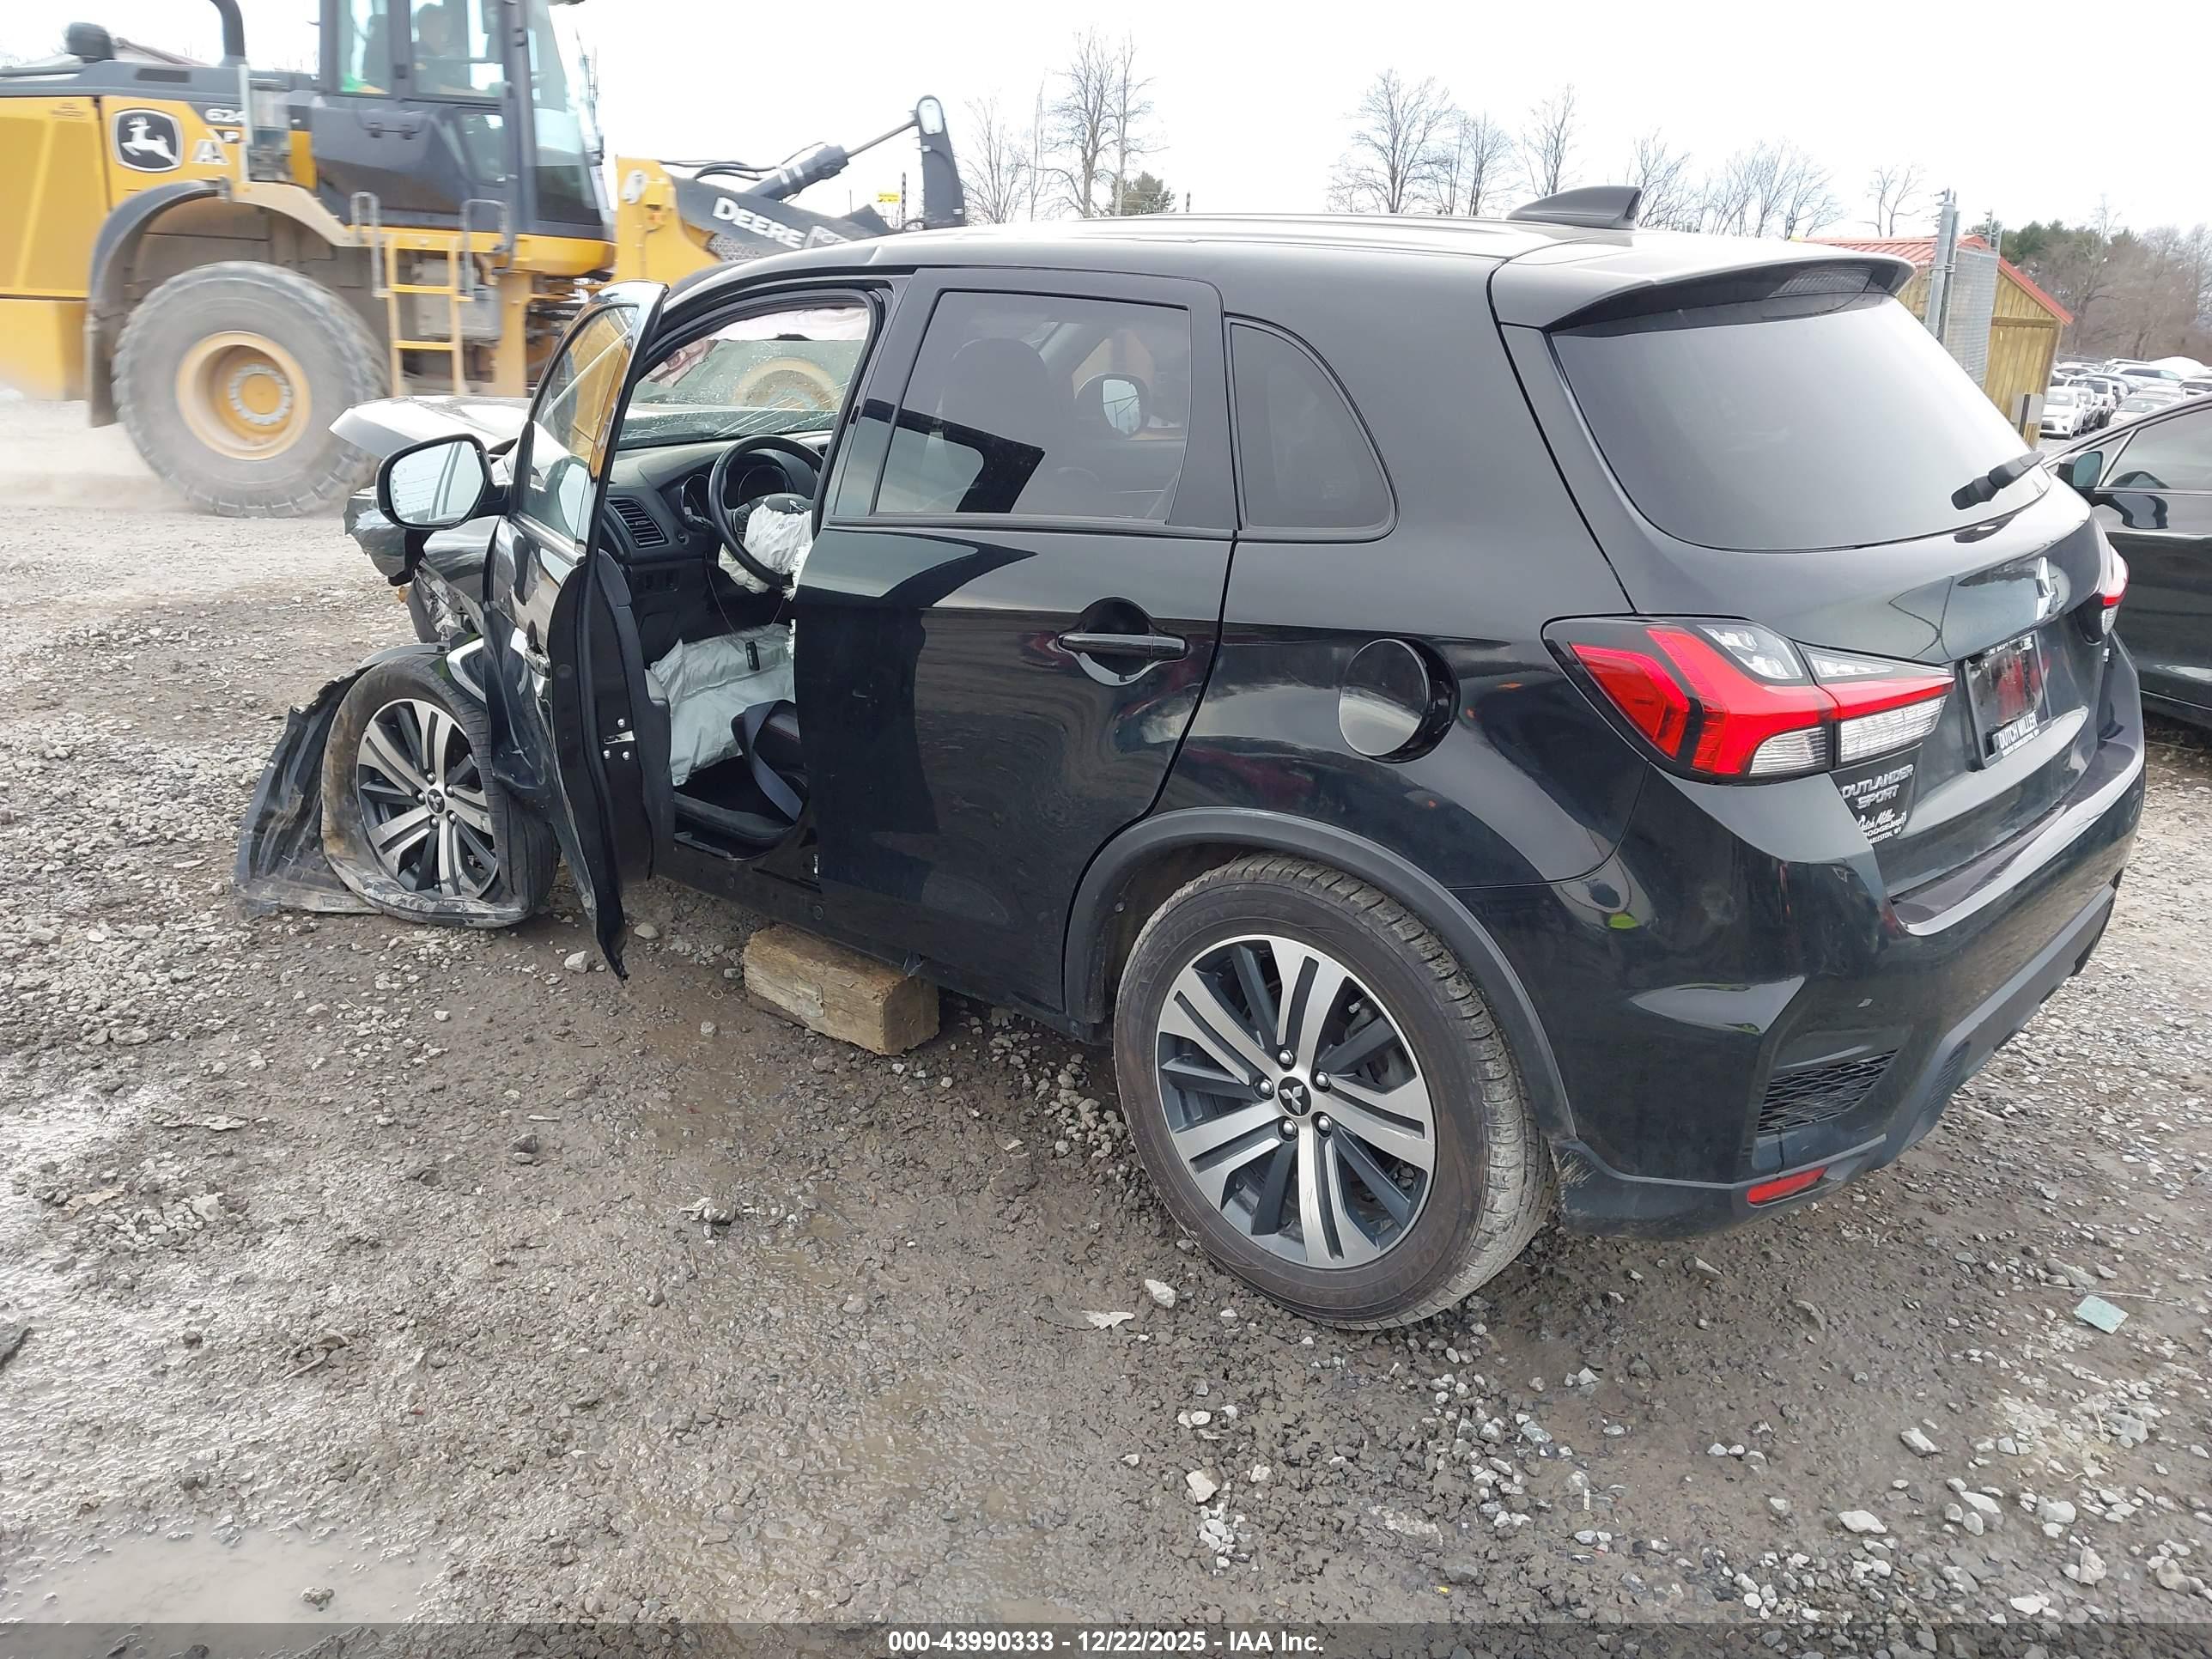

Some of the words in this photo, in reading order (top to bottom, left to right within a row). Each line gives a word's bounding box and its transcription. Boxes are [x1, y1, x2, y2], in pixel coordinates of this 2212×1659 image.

[712, 197, 806, 249] DEERE
[1840, 763, 1914, 799] OUTLANDER
[1856, 784, 1900, 809] SPORT
